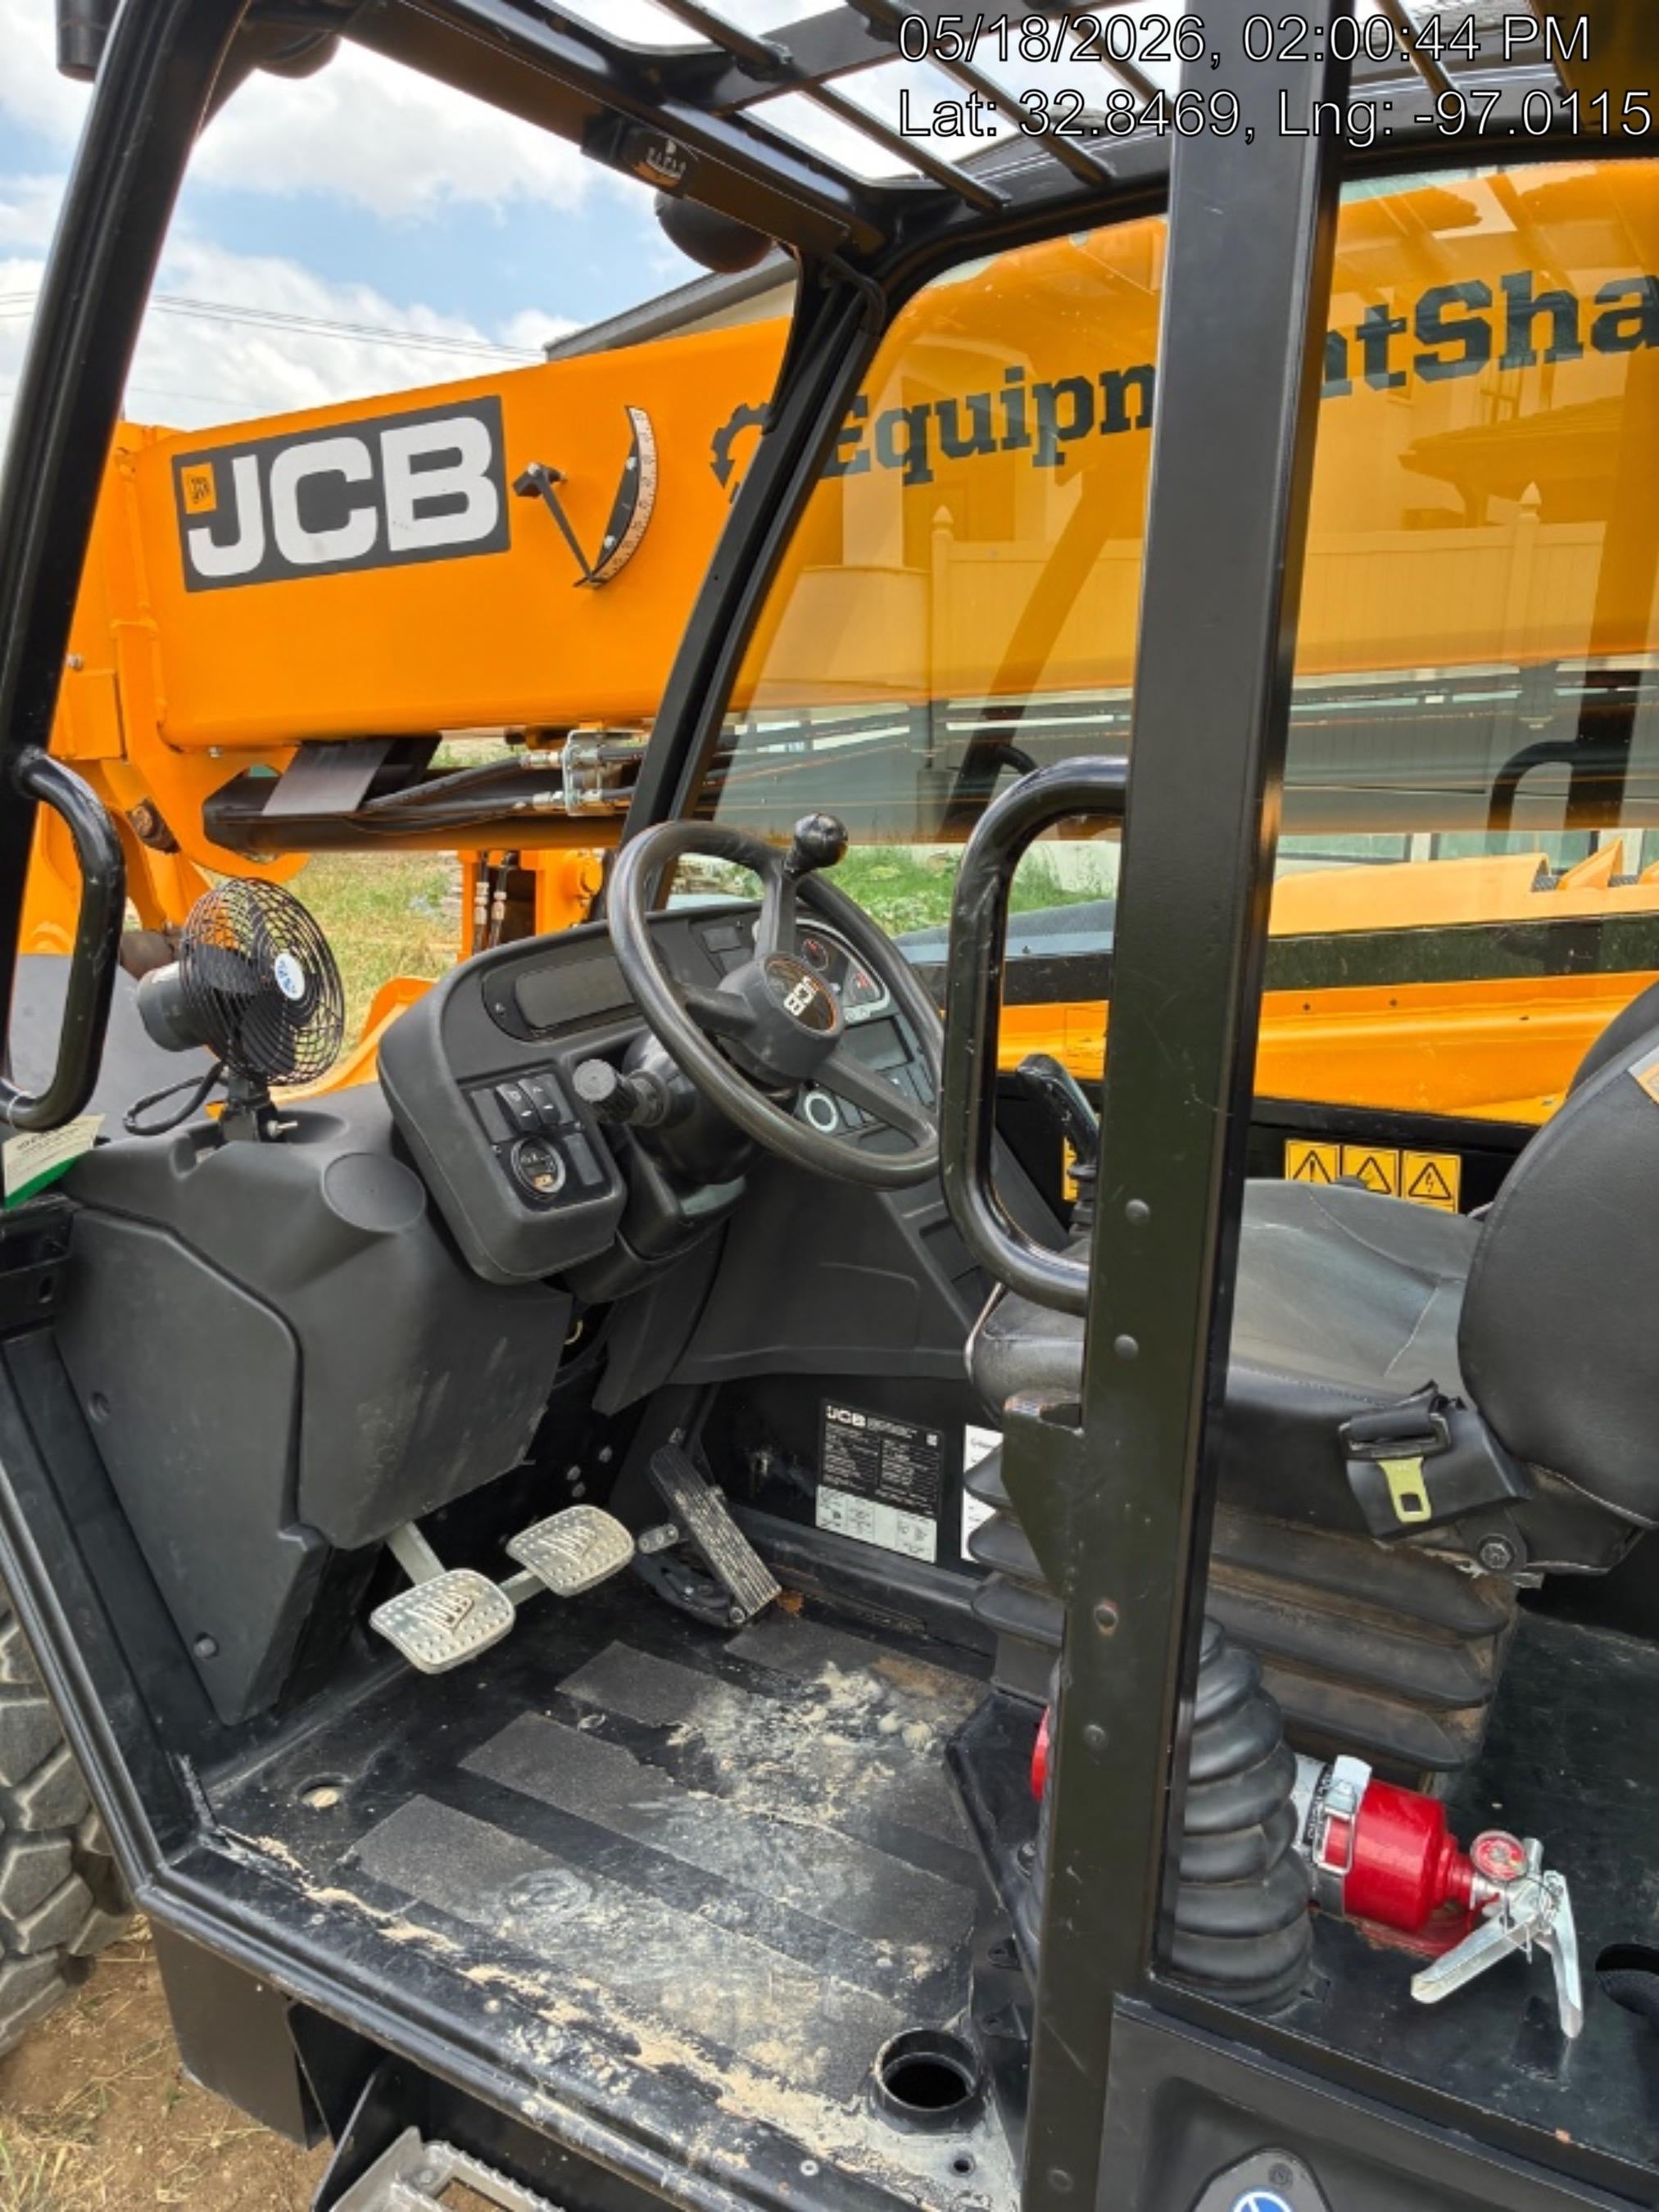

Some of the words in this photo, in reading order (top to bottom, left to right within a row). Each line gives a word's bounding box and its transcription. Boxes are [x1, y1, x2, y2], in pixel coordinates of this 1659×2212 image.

[187, 415, 499, 578] JCB
[783, 975, 818, 1017] JCB
[826, 1404, 866, 1428] JCB
